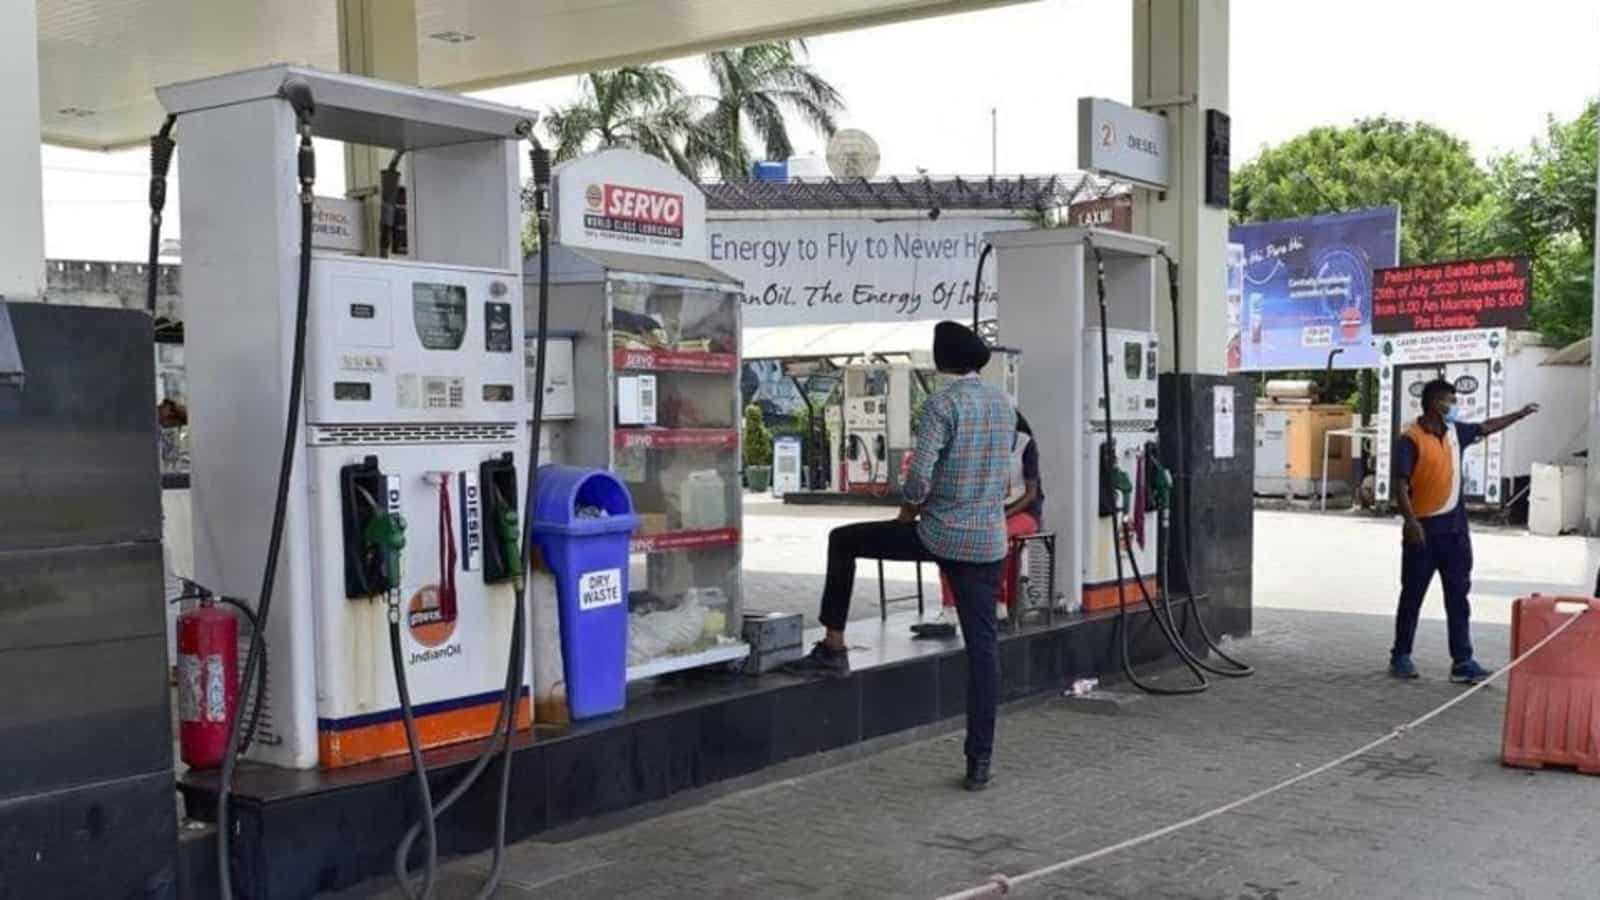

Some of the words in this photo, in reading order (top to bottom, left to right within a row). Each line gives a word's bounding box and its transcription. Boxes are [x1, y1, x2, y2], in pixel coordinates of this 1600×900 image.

[1127, 133, 1160, 157] DIESEL
[609, 189, 680, 222] SERVO
[710, 233, 791, 267] Energy
[799, 235, 818, 261] to
[827, 232, 857, 266] Fly
[866, 234, 889, 260] to
[894, 232, 959, 259] Newer
[1384, 270, 1412, 283] Petrol
[1415, 267, 1442, 281] Pump
[1480, 263, 1495, 273] on
[1496, 260, 1514, 272] the
[804, 280, 843, 306] The
[851, 283, 922, 314] Energy
[932, 282, 955, 310] Of
[1398, 286, 1408, 297] of
[1409, 285, 1429, 298] July
[1375, 304, 1396, 316] from
[1441, 297, 1482, 311] Morning
[1485, 295, 1496, 306] to
[1499, 293, 1524, 306] 5.00
[624, 352, 656, 369] SERVO
[467, 485, 480, 557] DIESEL
[590, 575, 611, 590] DRY
[584, 586, 618, 604] WASTE
